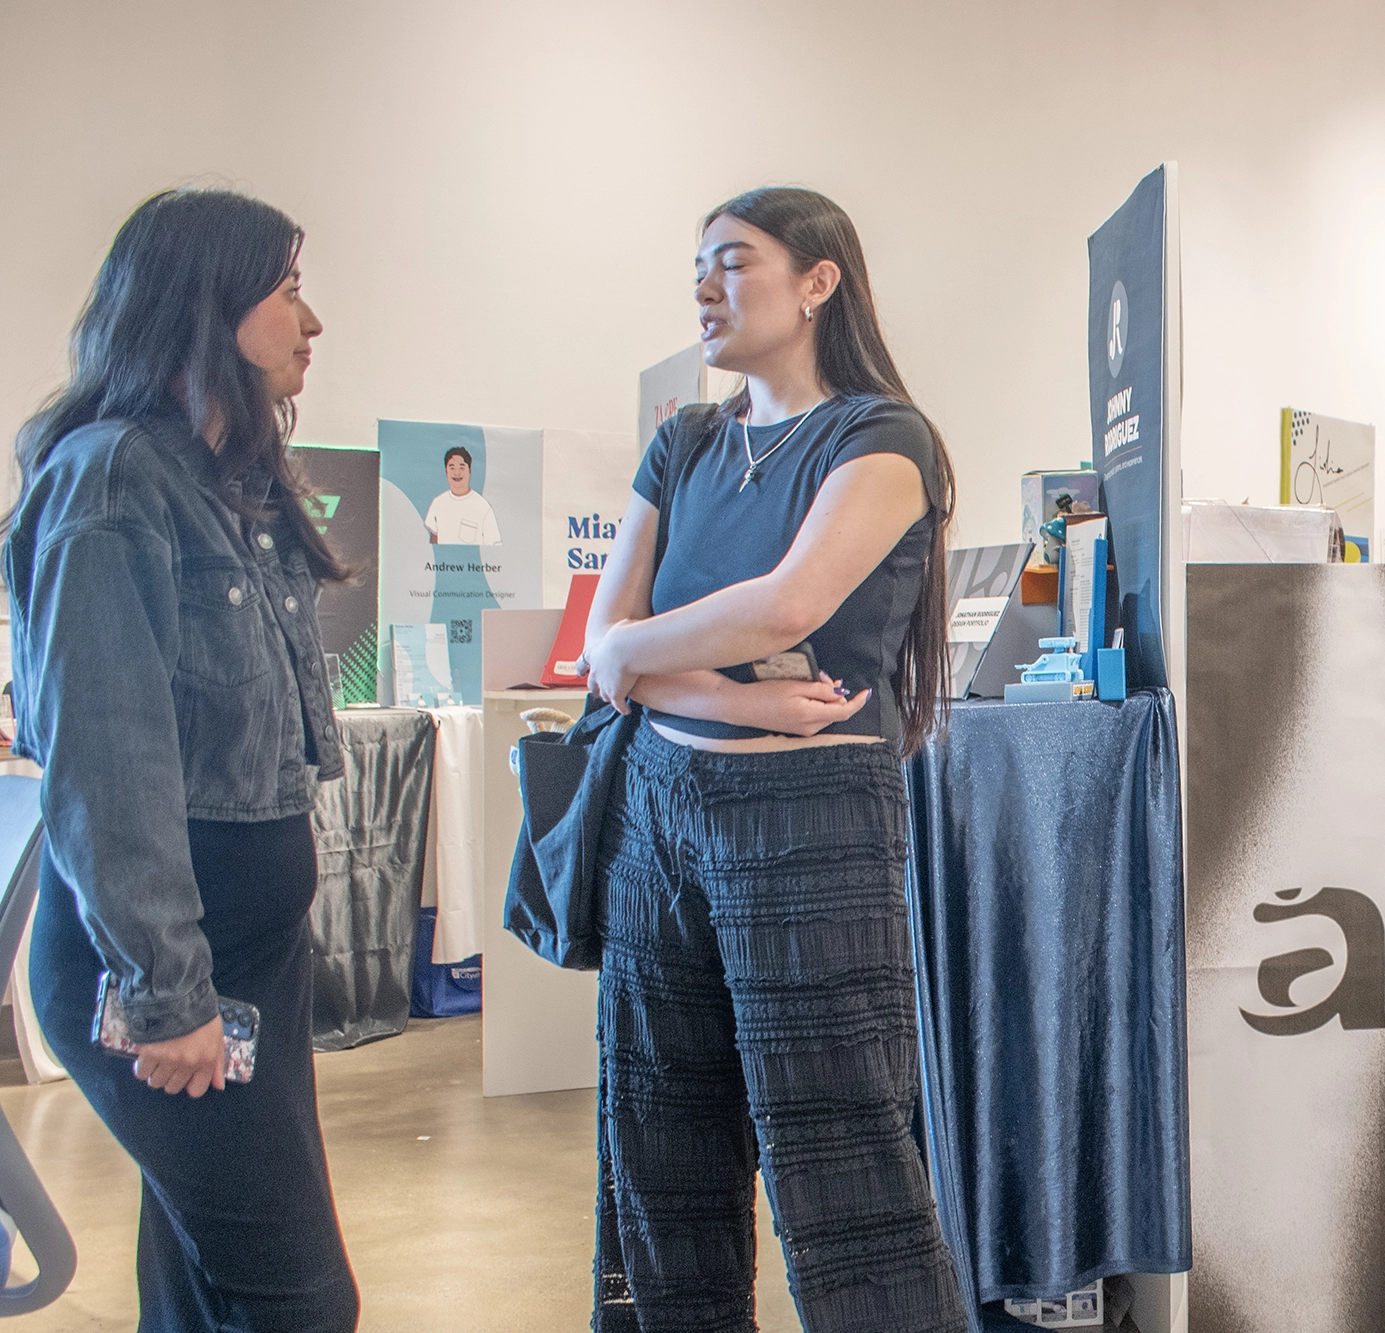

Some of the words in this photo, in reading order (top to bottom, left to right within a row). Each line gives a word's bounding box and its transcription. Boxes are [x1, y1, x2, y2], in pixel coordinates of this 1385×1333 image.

[1107, 386, 1133, 426] JOHNNY
[1104, 414, 1140, 458] RODRIGUEZ
[567, 512, 623, 540] Mia
[424, 561, 465, 572] Andrew
[467, 562, 502, 573] Herber
[409, 590, 431, 598] Visual
[485, 590, 516, 600] Designer
